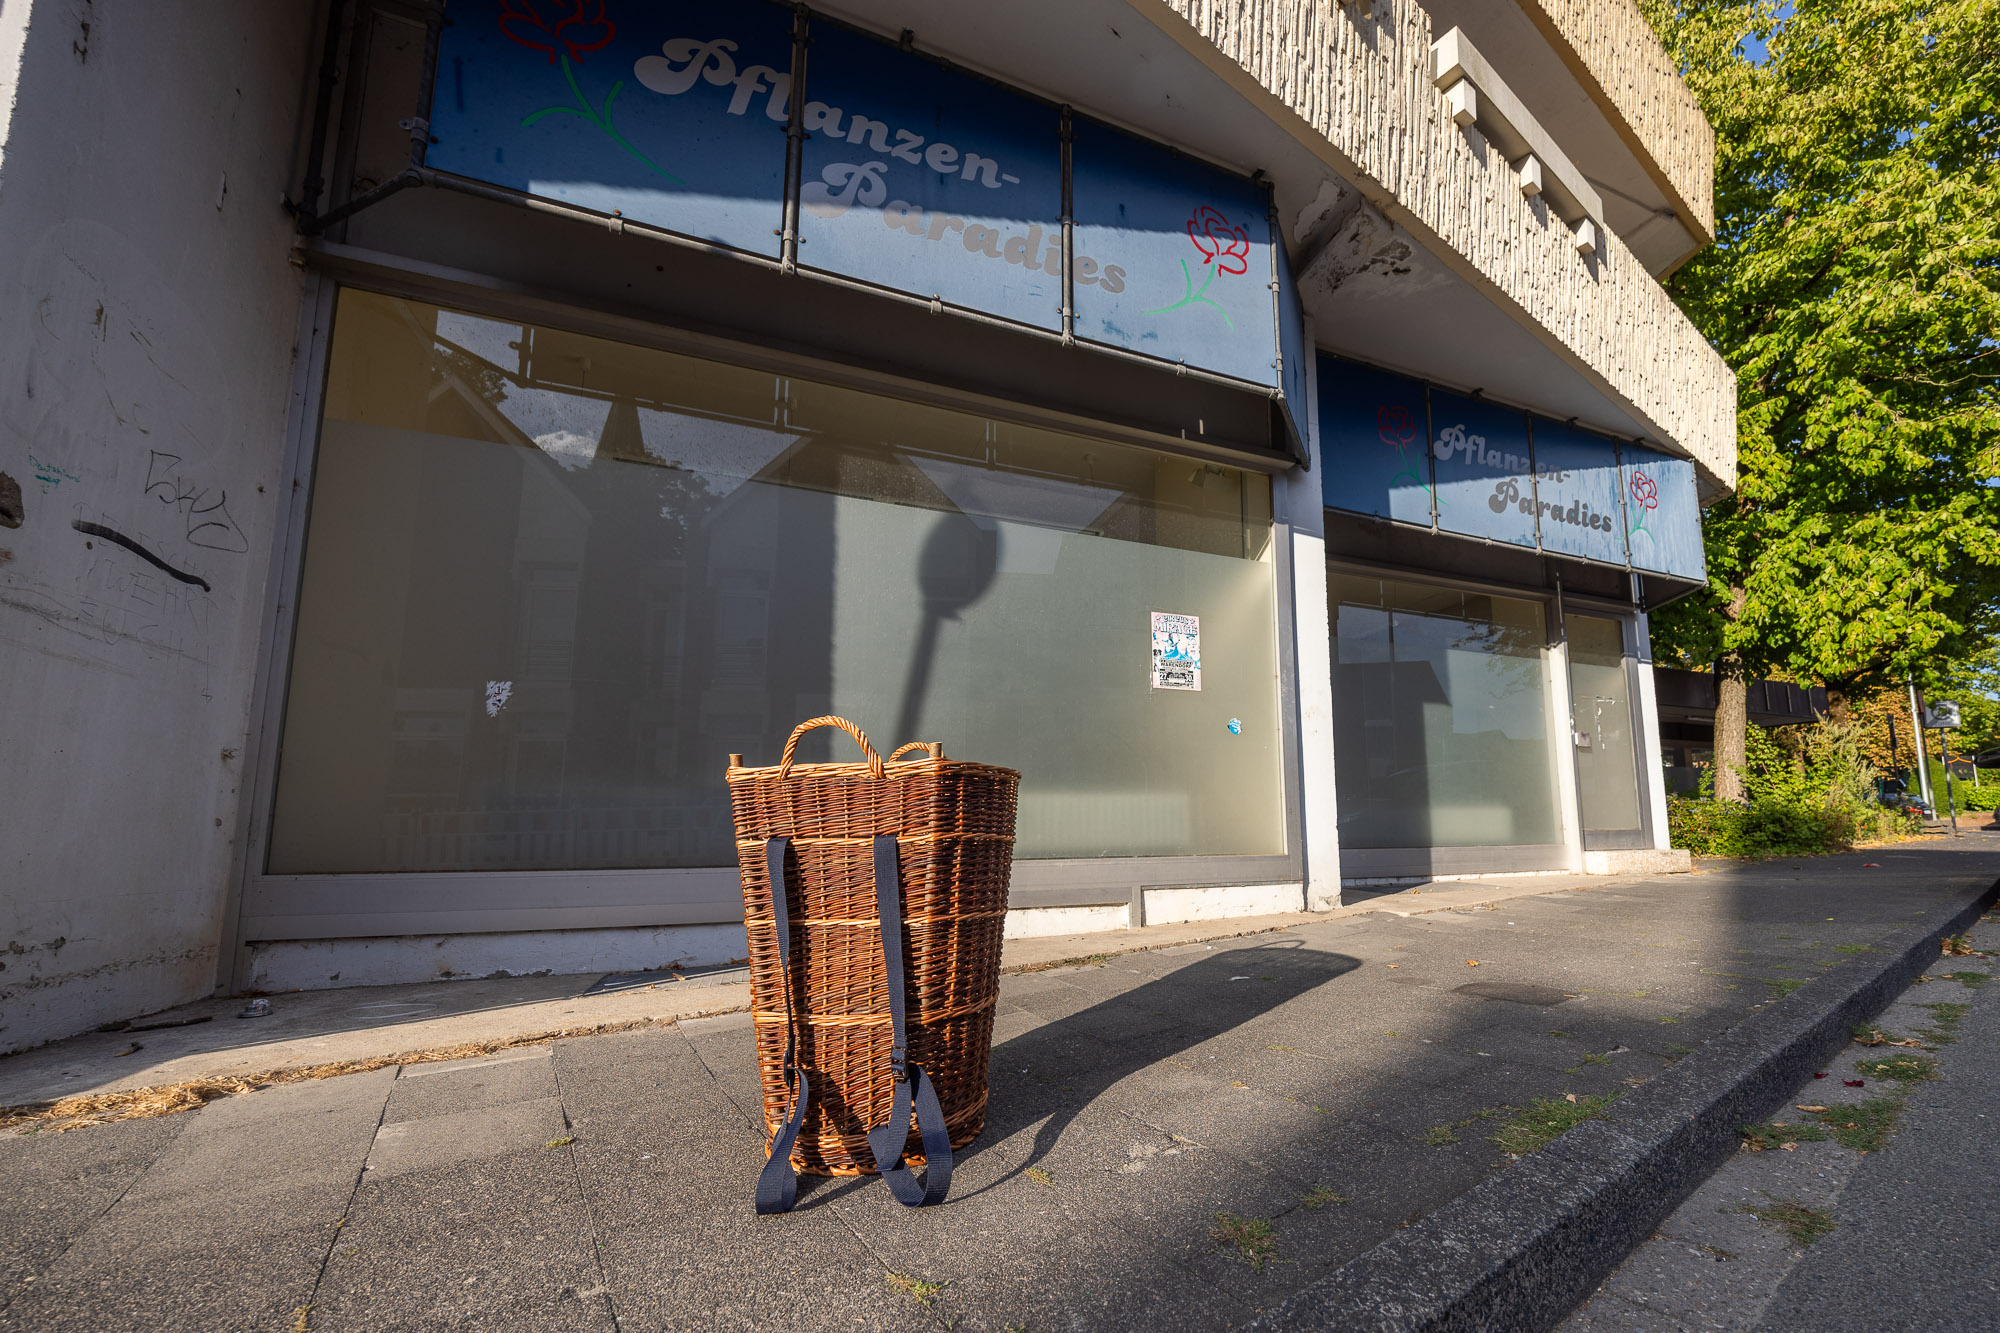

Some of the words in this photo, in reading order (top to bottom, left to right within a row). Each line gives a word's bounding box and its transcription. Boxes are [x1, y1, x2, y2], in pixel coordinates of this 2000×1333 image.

[634, 38, 1021, 188] Pflanzen-
[800, 161, 1126, 293] Paradies
[1433, 424, 1571, 483] Pflanzen-
[1488, 477, 1612, 532] Paradies
[1153, 621, 1198, 635] MIRAGE
